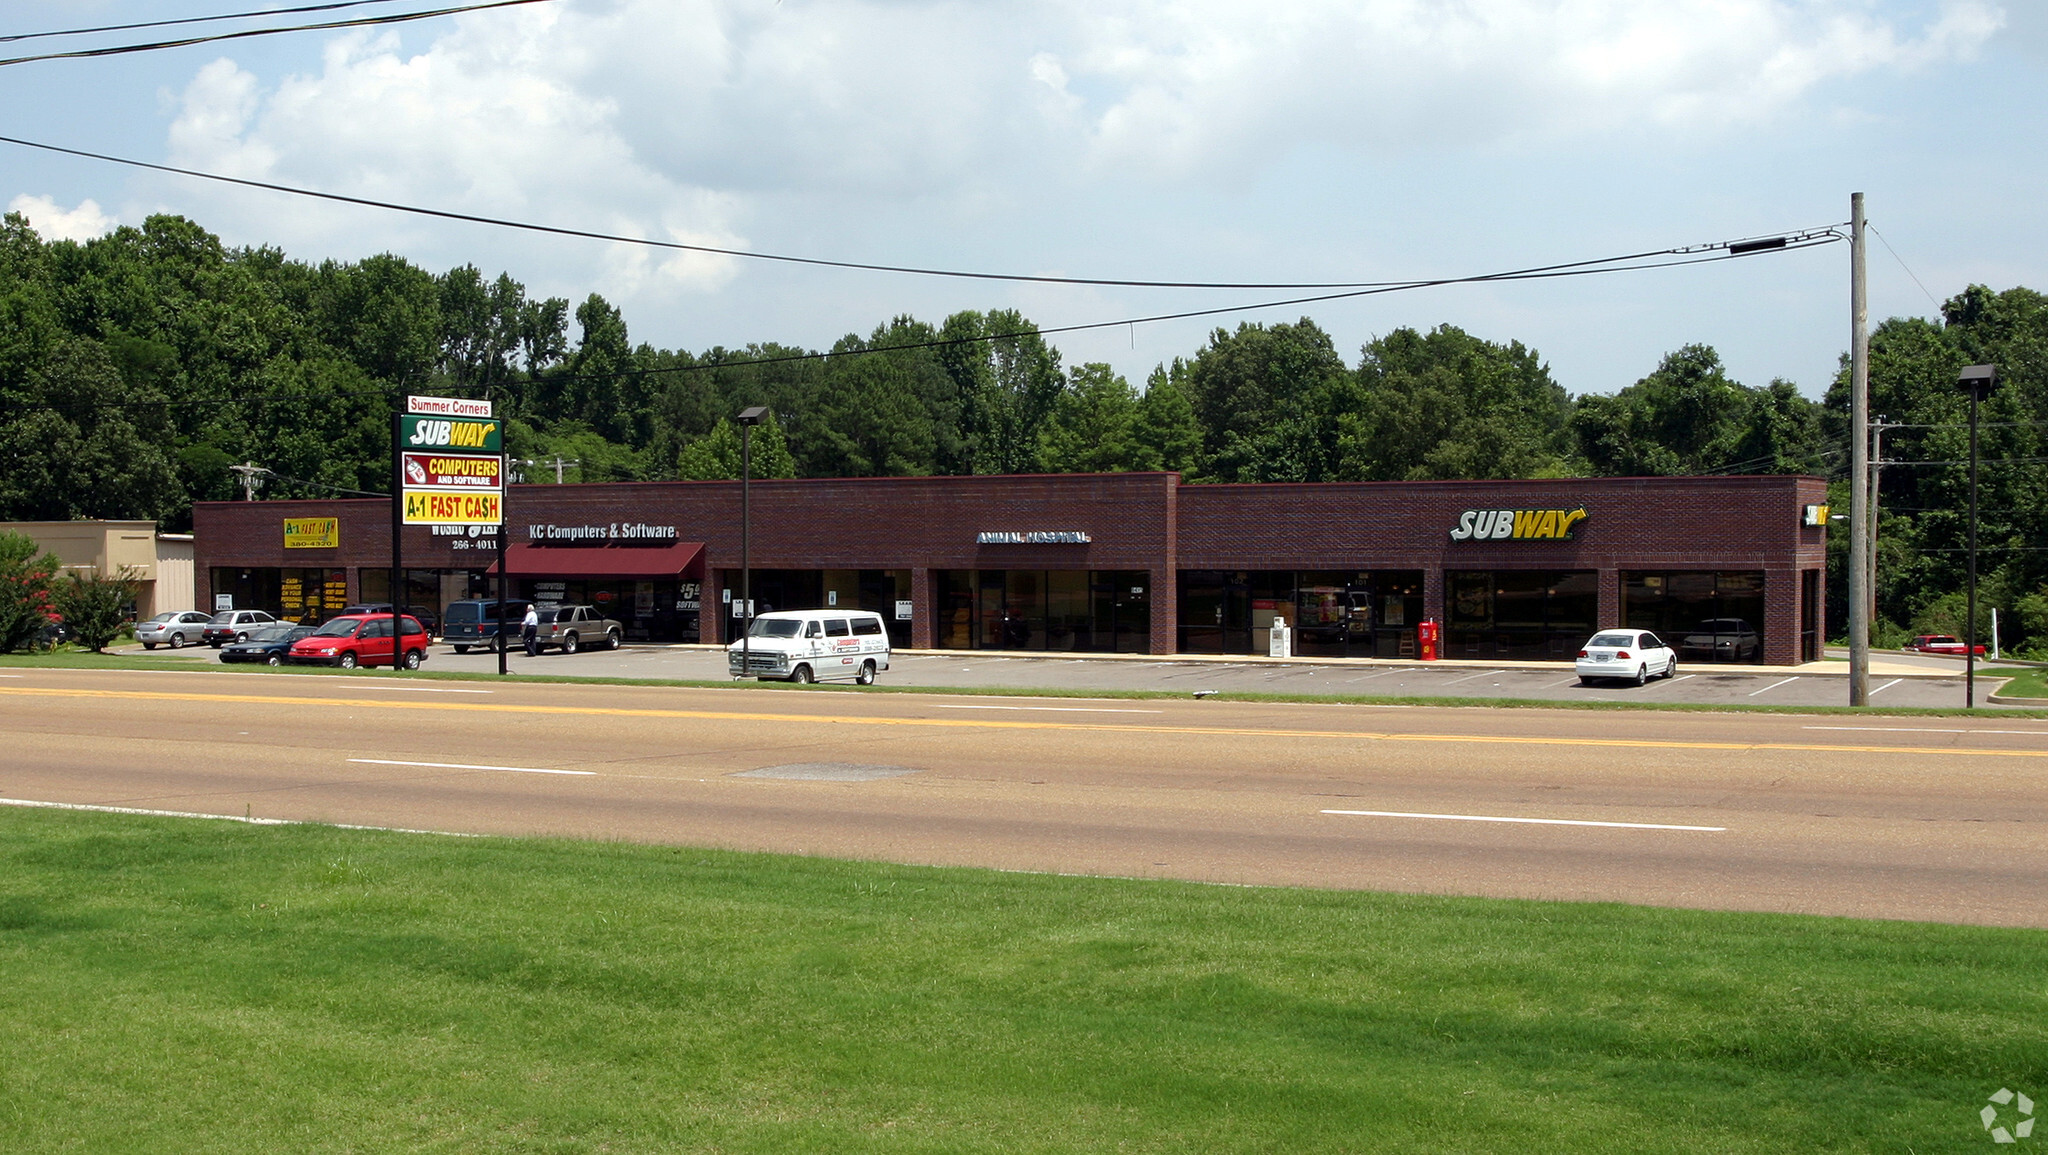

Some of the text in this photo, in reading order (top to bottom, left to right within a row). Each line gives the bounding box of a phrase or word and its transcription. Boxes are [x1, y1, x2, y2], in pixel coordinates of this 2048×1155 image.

[411, 398, 489, 415] Summer Corners
[409, 419, 496, 447] SUBWAY
[428, 458, 498, 476] COMPUTERS
[437, 475, 491, 486] AND SOFTWARE
[406, 495, 498, 520] A-1 FAST CA$H
[530, 522, 675, 541] KC Computers & Software
[1450, 508, 1588, 541] SUBWAY
[452, 540, 469, 550] 266
[475, 540, 498, 550] 4011
[976, 531, 1087, 544] ANIMAL HOSPITAL
